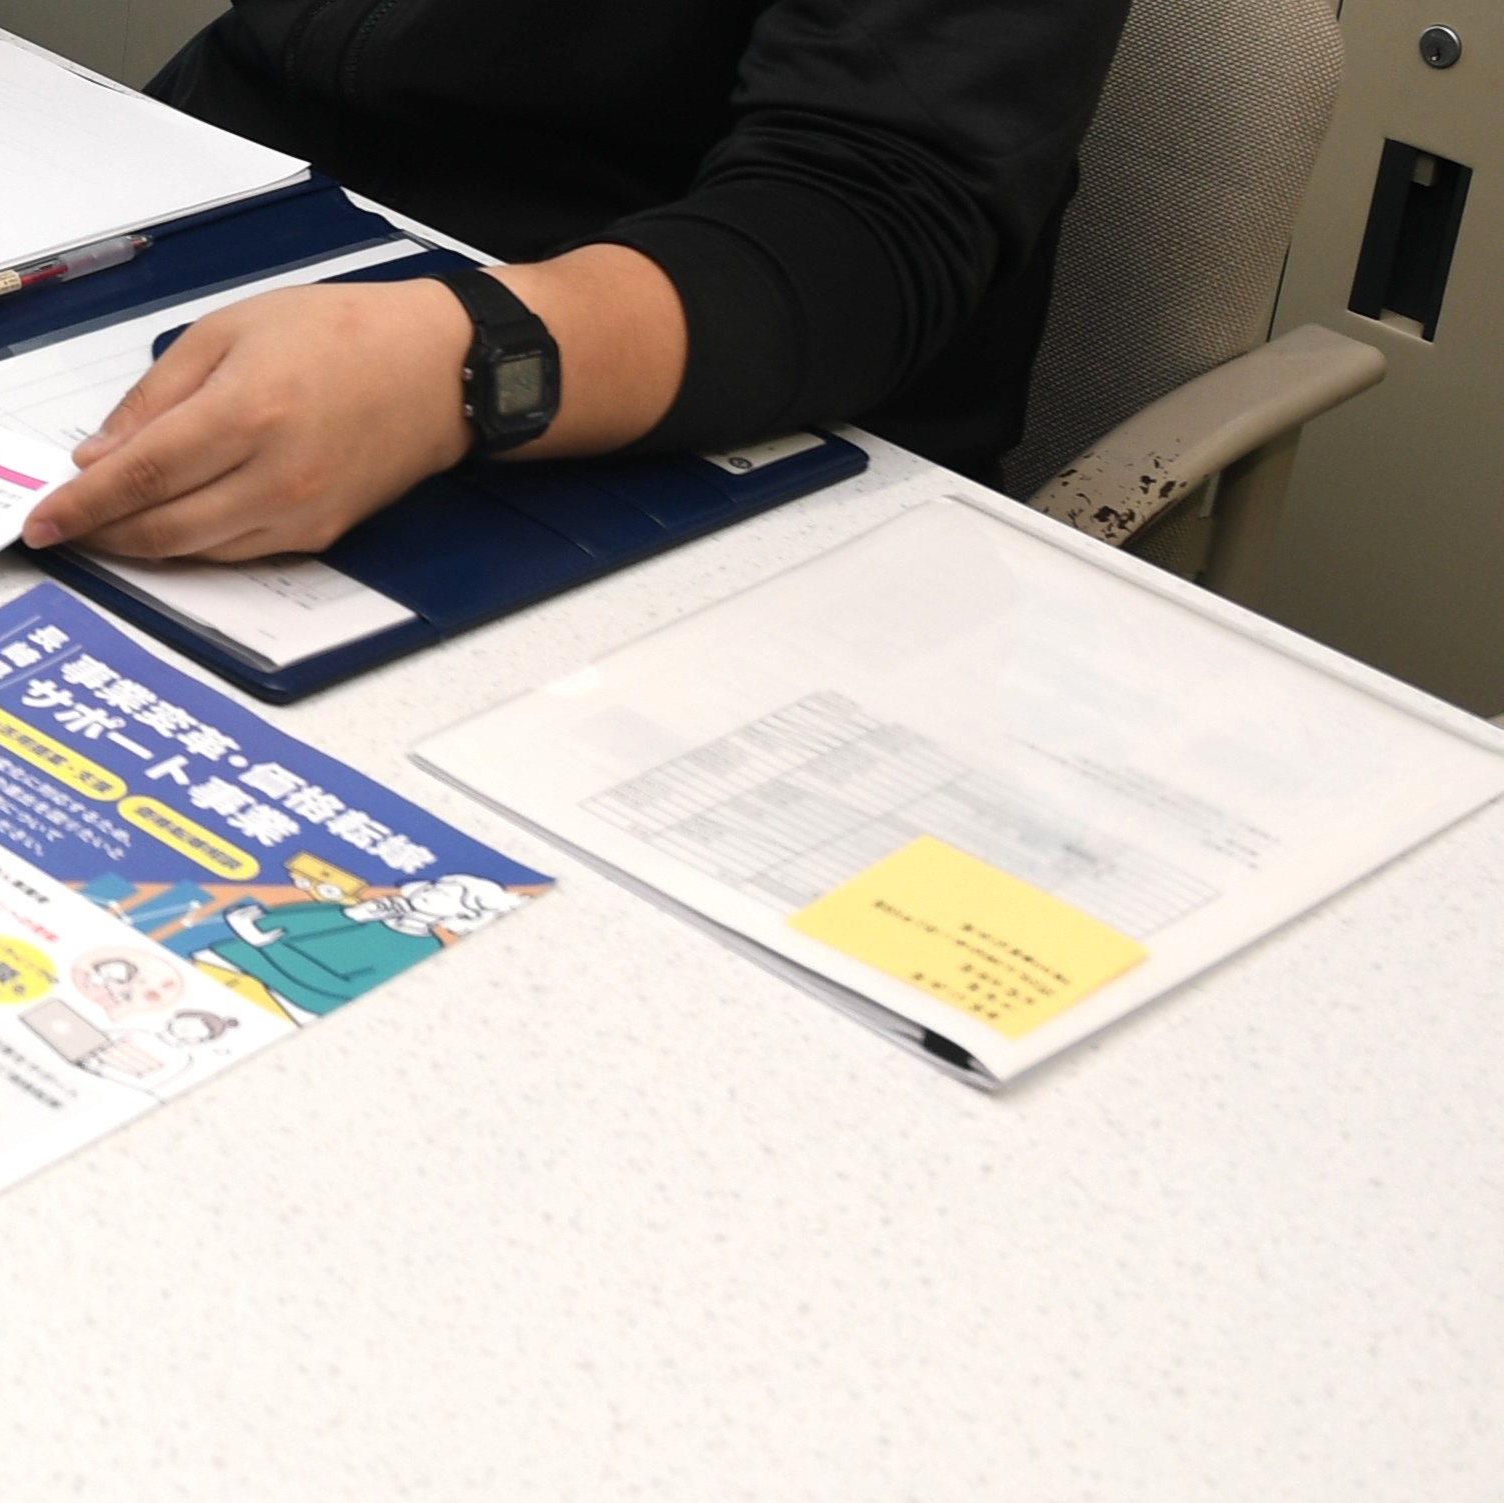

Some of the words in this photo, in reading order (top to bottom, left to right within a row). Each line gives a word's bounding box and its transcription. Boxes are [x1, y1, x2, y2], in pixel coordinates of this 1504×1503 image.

[6, 675, 307, 849] サポート事業
[51, 653, 442, 877] 事業変革・価格転嫁
